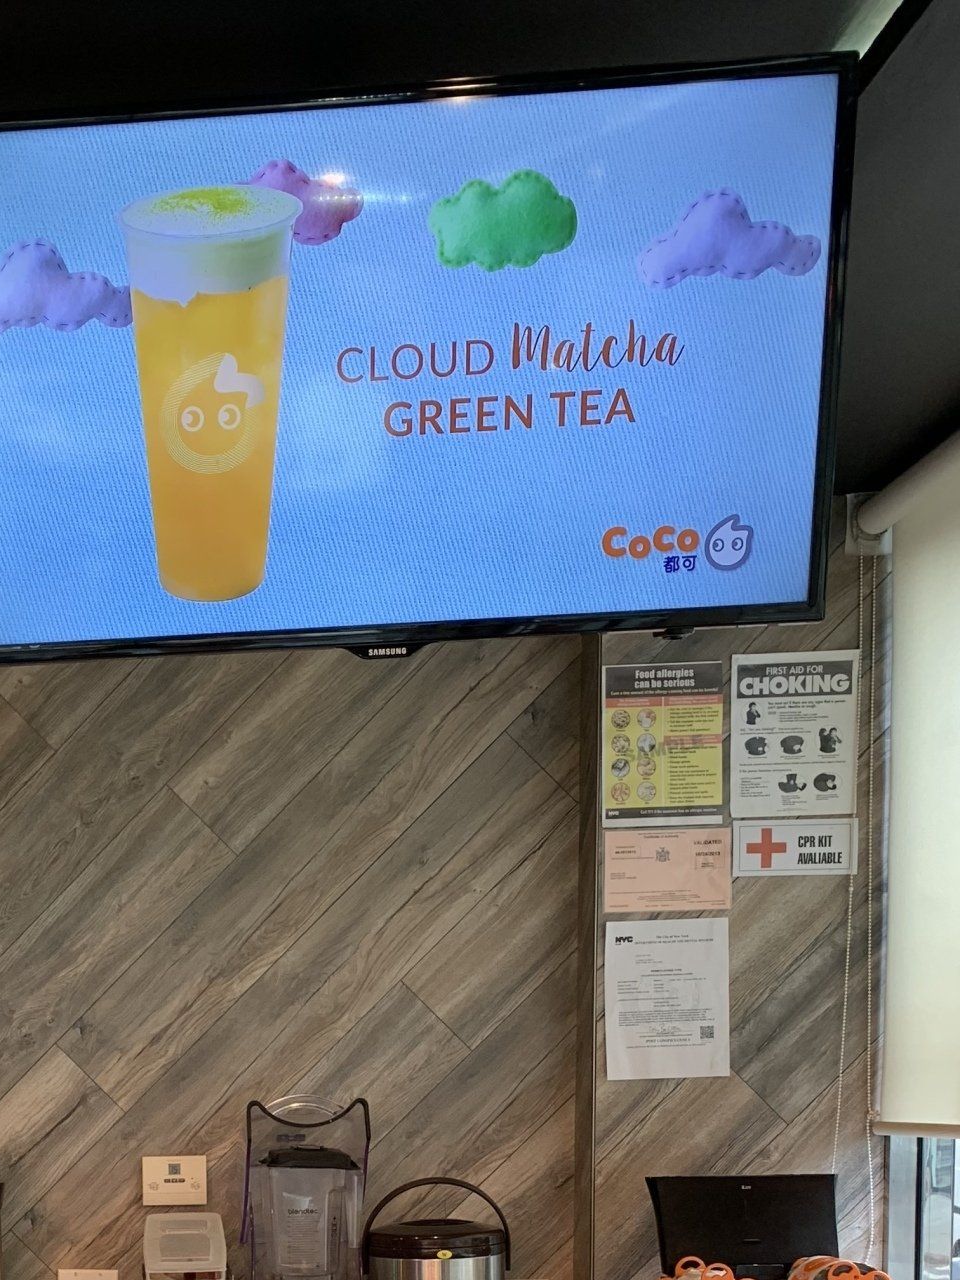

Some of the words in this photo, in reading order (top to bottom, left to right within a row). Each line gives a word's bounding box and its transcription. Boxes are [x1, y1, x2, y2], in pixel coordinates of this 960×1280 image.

[337, 339, 495, 383] CLOUD
[511, 319, 685, 372] Matcha
[384, 394, 533, 437] GREEN
[550, 387, 635, 427] TEA
[601, 526, 699, 559] CoCo
[663, 555, 697, 573] 都可
[368, 647, 407, 656] SAMSUNG
[635, 670, 654, 678] Food
[656, 669, 694, 678] allergies
[766, 666, 787, 675] FIRST
[790, 666, 804, 674] AID
[807, 665, 823, 673] FOR
[635, 680, 650, 688] can
[664, 679, 695, 687] serious
[740, 674, 850, 695] CHOKING
[798, 836, 815, 848] CPR
[818, 835, 832, 847] KIT
[797, 853, 842, 865] AVALIABLE
